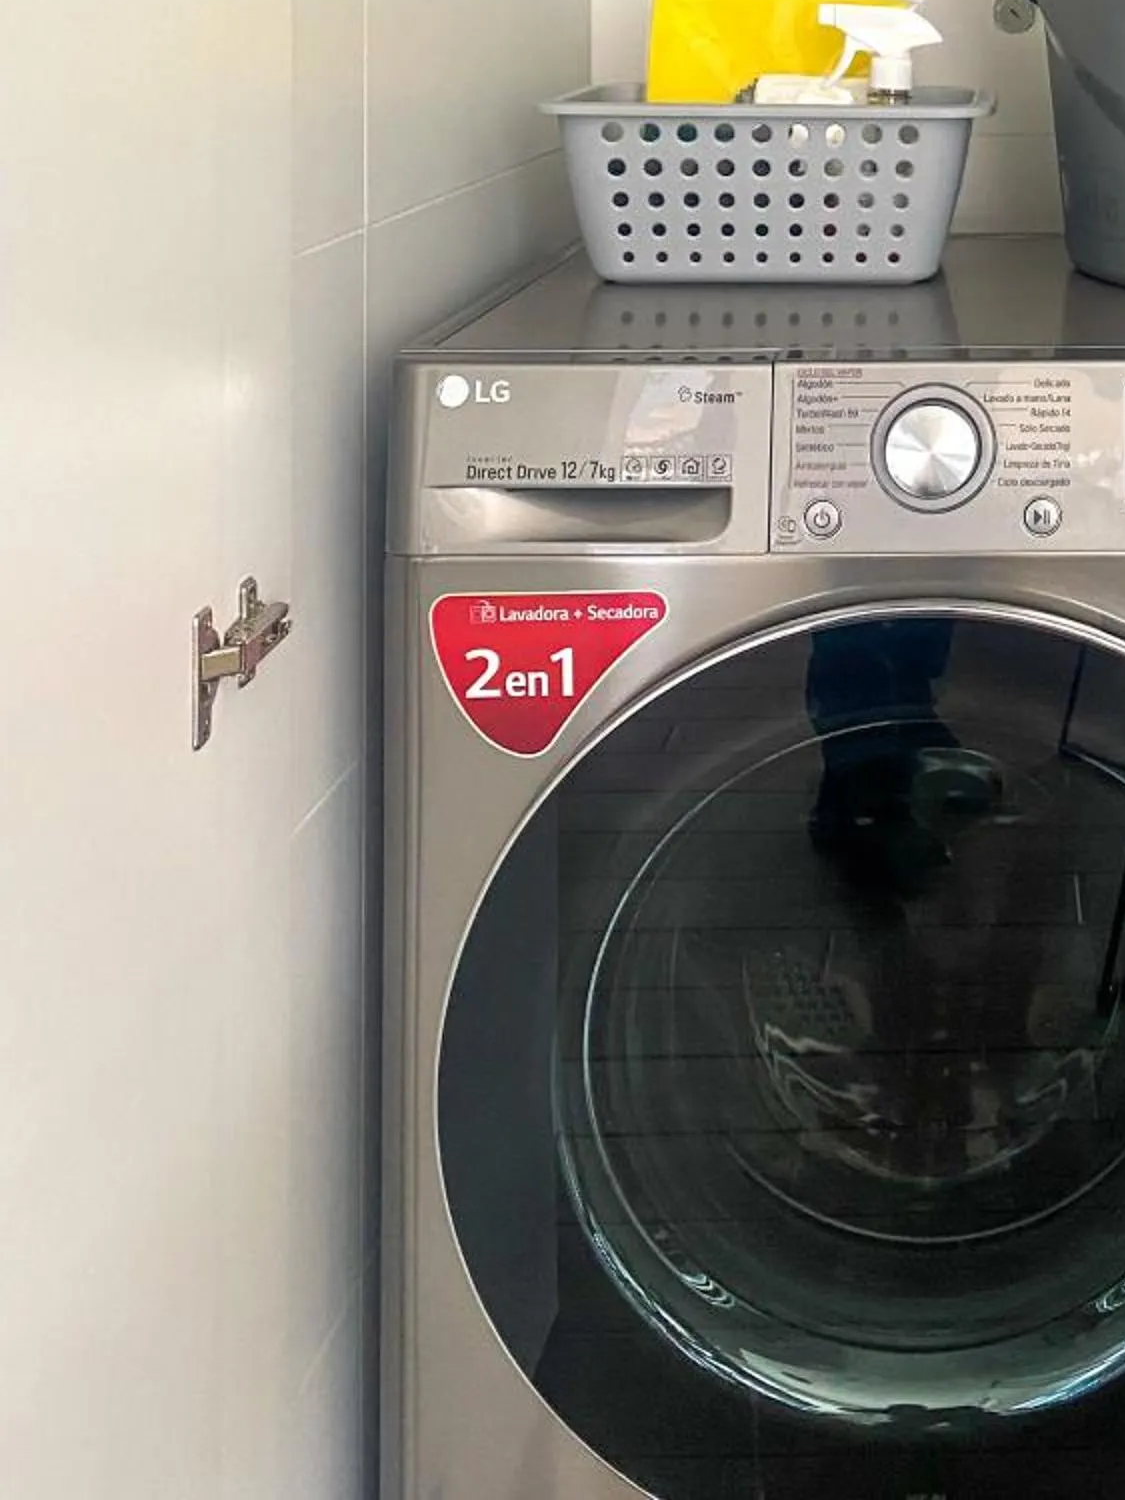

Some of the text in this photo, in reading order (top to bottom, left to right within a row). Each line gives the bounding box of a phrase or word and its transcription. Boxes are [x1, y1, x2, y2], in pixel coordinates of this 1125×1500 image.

[475, 380, 511, 403] LG
[466, 464, 513, 480] Direct
[516, 464, 557, 480] Drive
[500, 607, 569, 622] Lavadora
[587, 604, 659, 620] Secadora
